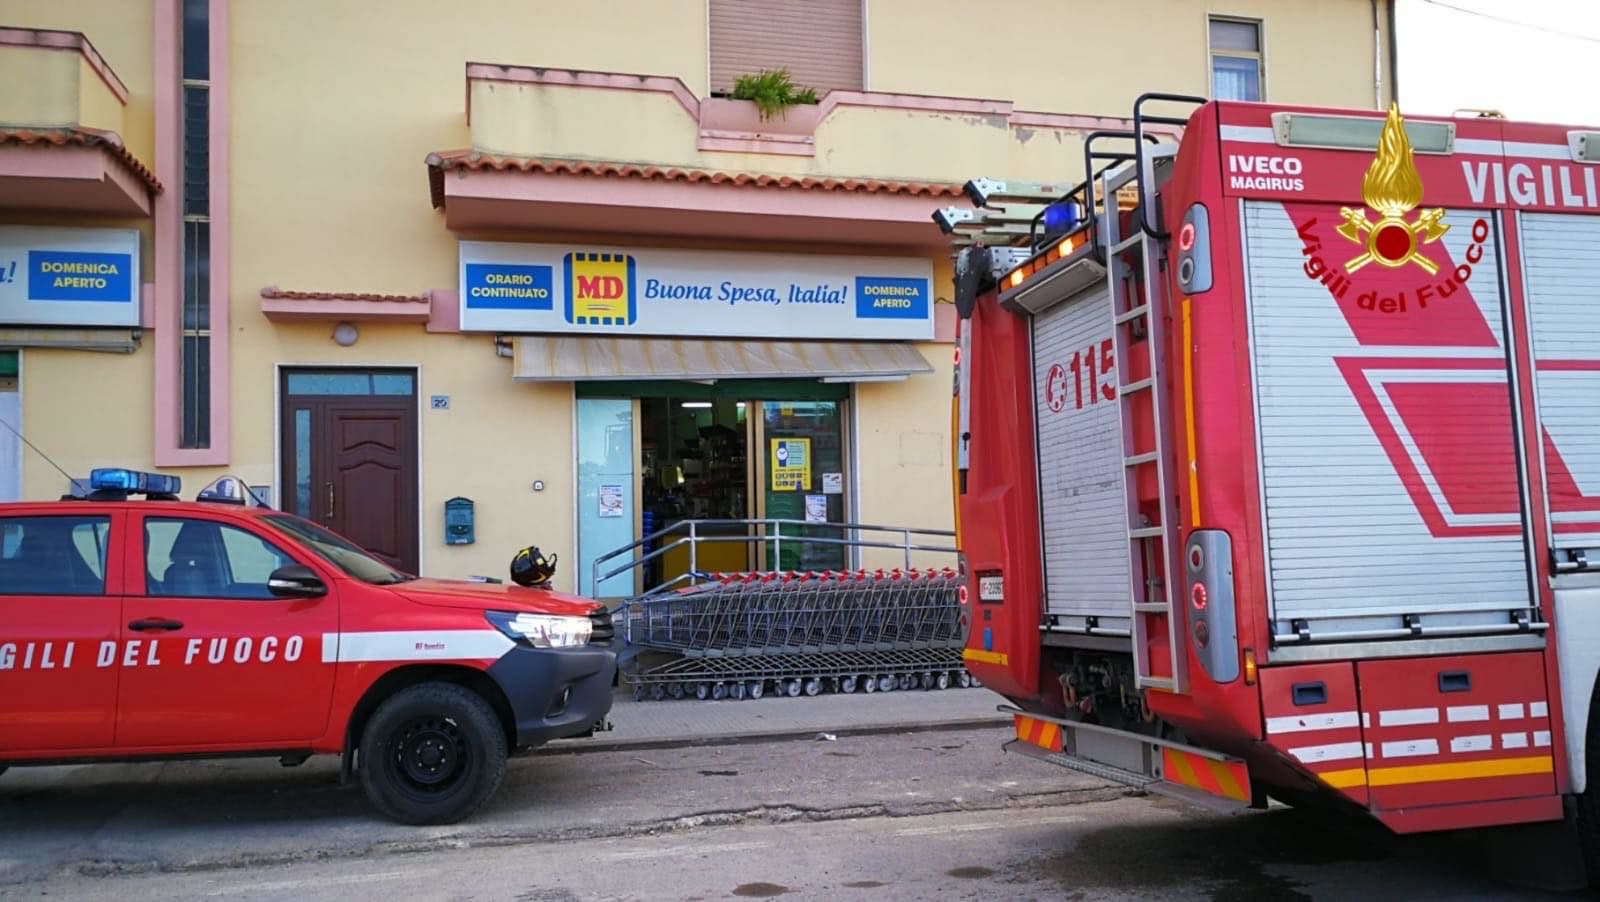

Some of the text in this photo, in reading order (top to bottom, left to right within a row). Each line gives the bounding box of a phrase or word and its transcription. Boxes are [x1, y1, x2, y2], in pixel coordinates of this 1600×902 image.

[1228, 154, 1303, 176] IVECO
[1230, 176, 1305, 192] MAGIRUS
[1461, 160, 1598, 208] VIGILI
[41, 262, 119, 275] DOMENICA
[53, 277, 107, 289] APERTO
[484, 273, 534, 285] ORARIO
[576, 275, 624, 299] MD
[471, 286, 549, 299] CONTINUATO
[644, 278, 848, 306] Buona Spesa, Italia!
[864, 285, 920, 297] DOMENICA
[873, 297, 912, 309] APERTO
[1070, 337, 1117, 410] 115
[96, 639, 161, 668] DEL
[184, 635, 303, 665] FUOCO
